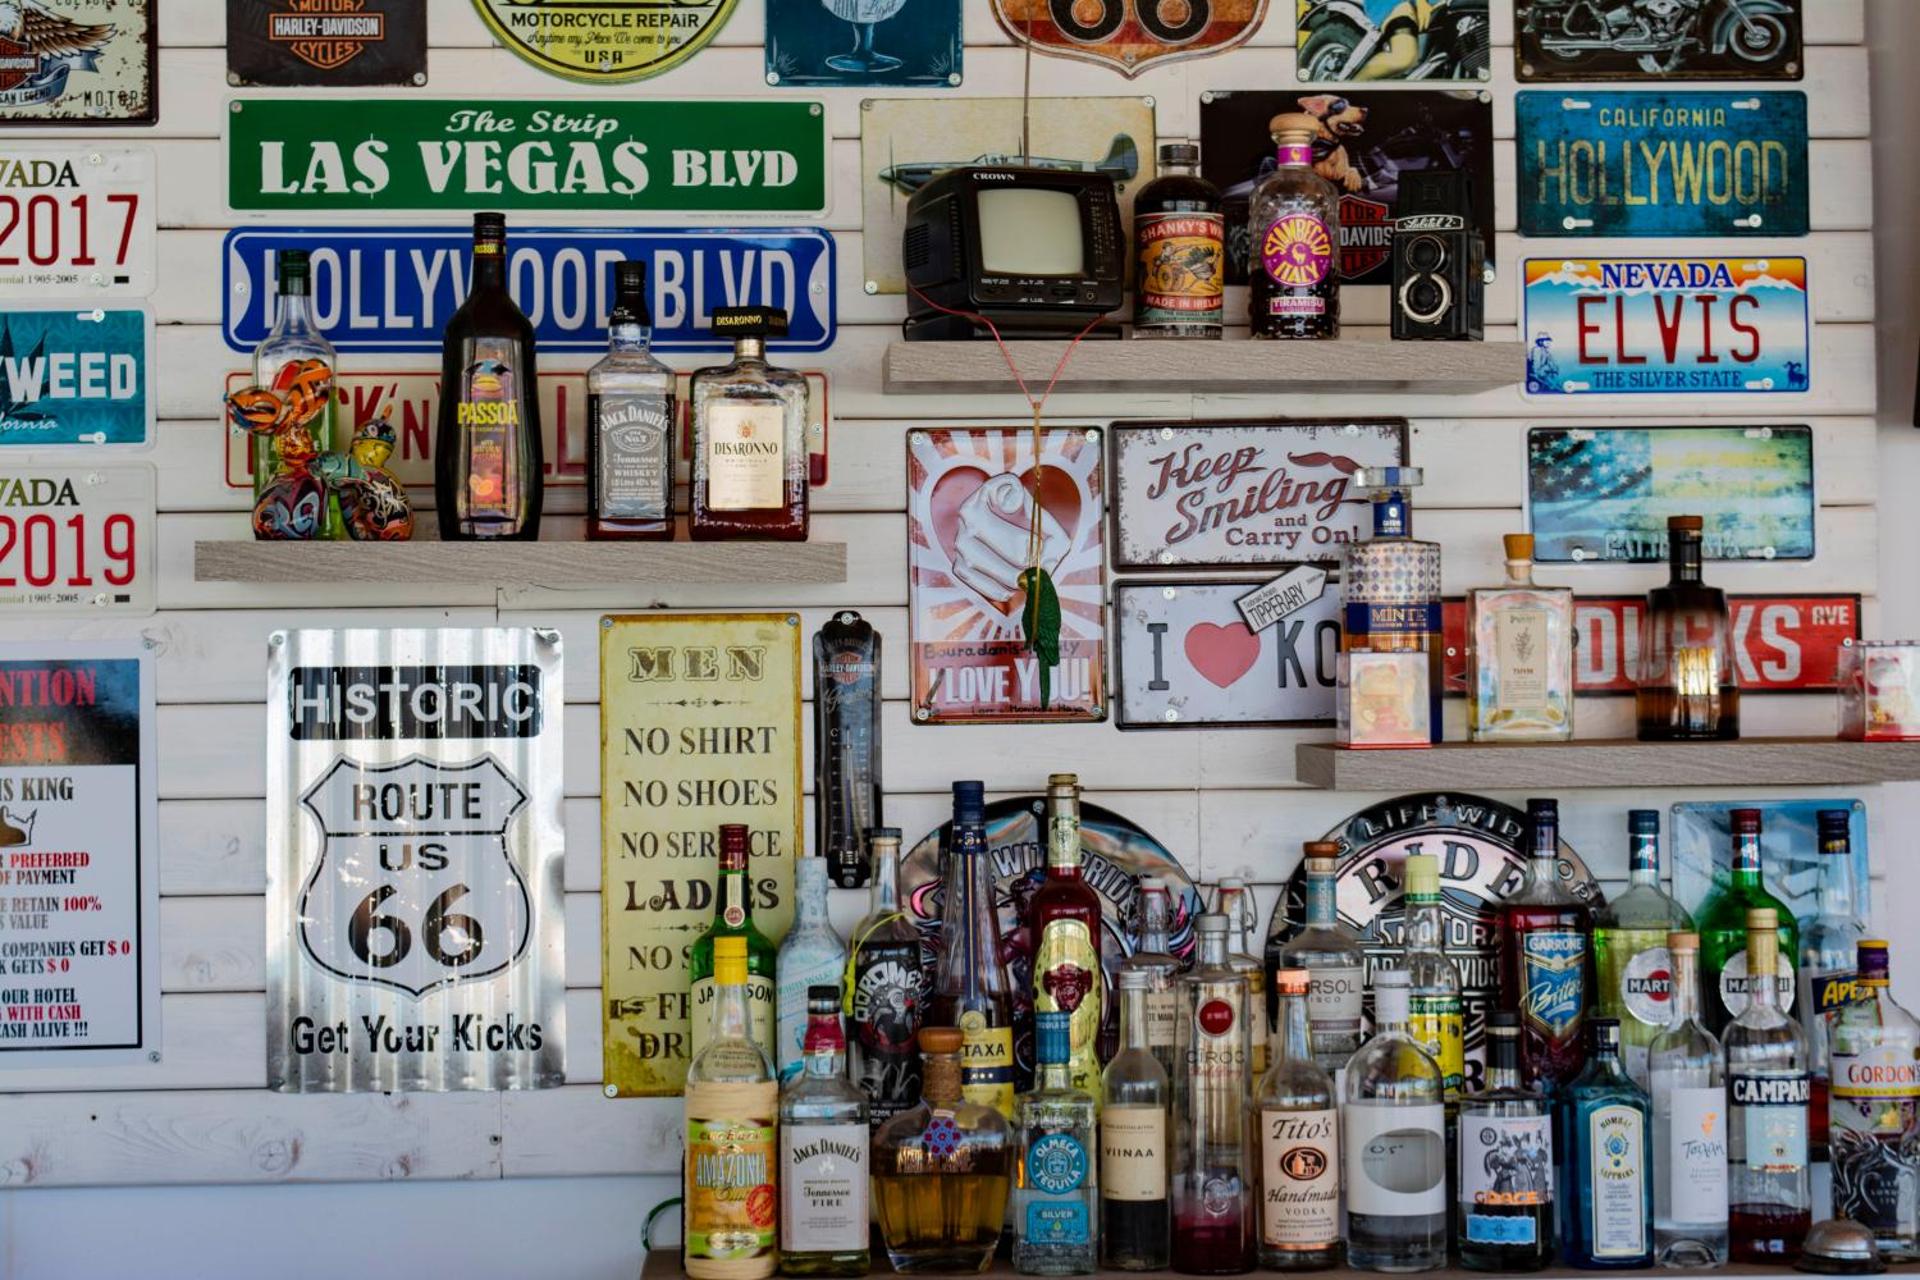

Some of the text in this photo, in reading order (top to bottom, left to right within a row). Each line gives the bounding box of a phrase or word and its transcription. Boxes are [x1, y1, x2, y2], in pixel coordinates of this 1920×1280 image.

[275, 18, 378, 36] HARLEY-DAVIDSON
[511, 13, 632, 28] MOTORCYCLE
[301, 42, 354, 64] CYCLES
[83, 90, 138, 107] MOTOR
[445, 110, 619, 139] The Strip
[1600, 108, 1727, 127] CALIFORNIA
[672, 150, 798, 187] BLVD
[973, 173, 1015, 181] CROWN
[1537, 140, 1790, 205] HOLLYWOOD
[1265, 217, 1331, 256] STAMBECCO
[28, 275, 79, 284] 1905-2005
[1273, 259, 1320, 284] ITALY
[1600, 263, 1736, 288] NEVADA
[654, 249, 796, 330] BLVD
[715, 315, 763, 328] DISARONNO
[1577, 295, 1761, 364] ELVIS
[0, 352, 137, 403] WEED
[1592, 371, 1742, 388] THE SILVER STATE
[600, 408, 627, 431] JACK
[714, 442, 778, 457] DISARONNO
[1148, 442, 1264, 500] Keep
[1165, 466, 1350, 545] Smiling
[1274, 514, 1308, 527] and
[1225, 527, 1300, 550] Carry
[1311, 525, 1360, 545] On!
[1247, 581, 1307, 628] TIPPERARY
[1811, 605, 1849, 625] AVE
[628, 646, 767, 682] MEN
[1147, 622, 1170, 691] I
[945, 666, 1010, 704] LOVE
[294, 682, 536, 723] HISTORIC
[624, 727, 778, 755] NO SHIRT
[22, 777, 74, 801] KING
[352, 782, 482, 820] ROUTE
[623, 779, 779, 807] NO SHOES
[1456, 804, 1526, 838] WID
[620, 830, 783, 859] NO SERCE
[10, 853, 91, 868] PREFERRED
[379, 844, 450, 871] US
[17, 869, 77, 885] PAYMENT
[12, 896, 102, 912] RETAIN 100%
[11, 914, 49, 930] VALUE
[347, 883, 484, 969] 66
[4, 941, 76, 957] COMPANIES
[80, 941, 105, 956] GET
[628, 946, 673, 971] NO
[12, 959, 45, 975] GETS
[2, 988, 78, 1004] OUR HOTEL
[1628, 978, 1670, 993] MART
[8, 1005, 81, 1021] WITH CASH
[32, 1022, 70, 1037] ALIVE
[290, 1013, 544, 1055] Get Your Kicks
[963, 1042, 1006, 1057] TAXA
[1733, 1078, 1811, 1103] CAMPAR
[1272, 1116, 1332, 1140] Tito's
[792, 1138, 862, 1165] JACK DANIEL'S
[1035, 1139, 1080, 1158] OLMECA
[1033, 1168, 1081, 1190] TEQUILA
[812, 1199, 843, 1208] FIRE
[1041, 1210, 1074, 1220] SILVER
[1285, 1207, 1326, 1216] VODKA
